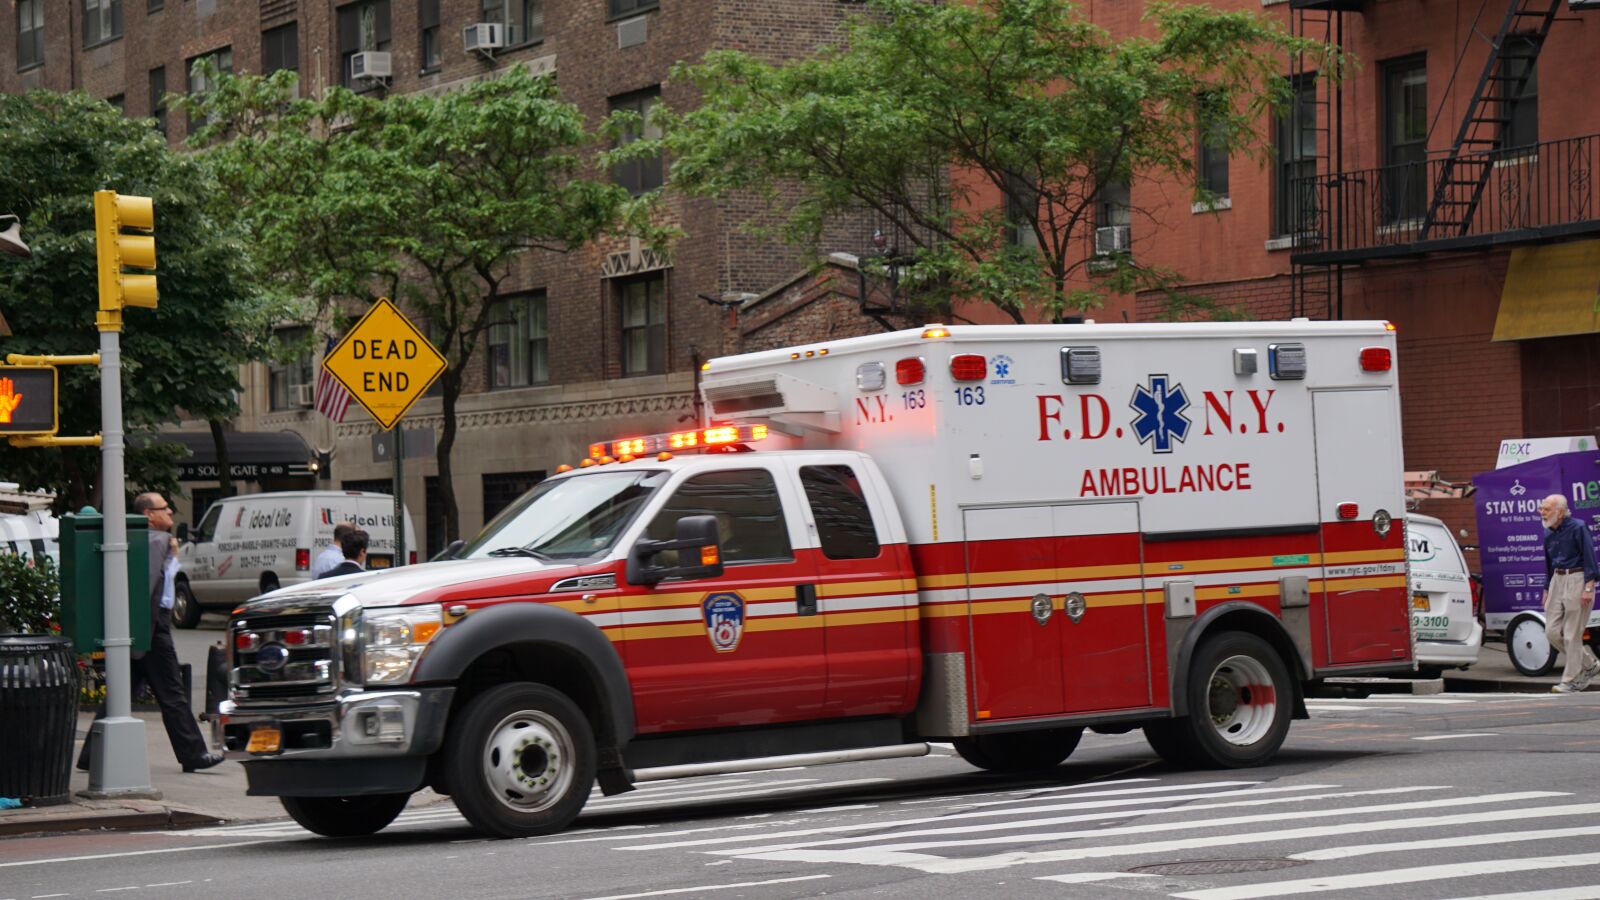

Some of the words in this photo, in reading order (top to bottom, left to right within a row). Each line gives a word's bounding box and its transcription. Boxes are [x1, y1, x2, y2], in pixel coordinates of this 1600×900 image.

[353, 340, 418, 360] DEAD
[364, 371, 409, 392] END
[954, 386, 985, 406] 163
[856, 394, 893, 426] N.Y.
[902, 389, 926, 410] 163
[1036, 393, 1123, 442] F.D.
[1202, 389, 1285, 436] N.Y.
[1501, 442, 1531, 455] next
[198, 465, 258, 477] SOUGATE
[1080, 463, 1252, 498] AMBULANCE
[1572, 480, 1600, 502] ne
[1486, 501, 1515, 516] STAY
[1517, 499, 1544, 514] HO
[249, 509, 275, 530] ideal
[275, 507, 292, 527] tile
[344, 513, 379, 526] ideal
[381, 514, 395, 527] til
[1516, 534, 1538, 542] DEMAND
